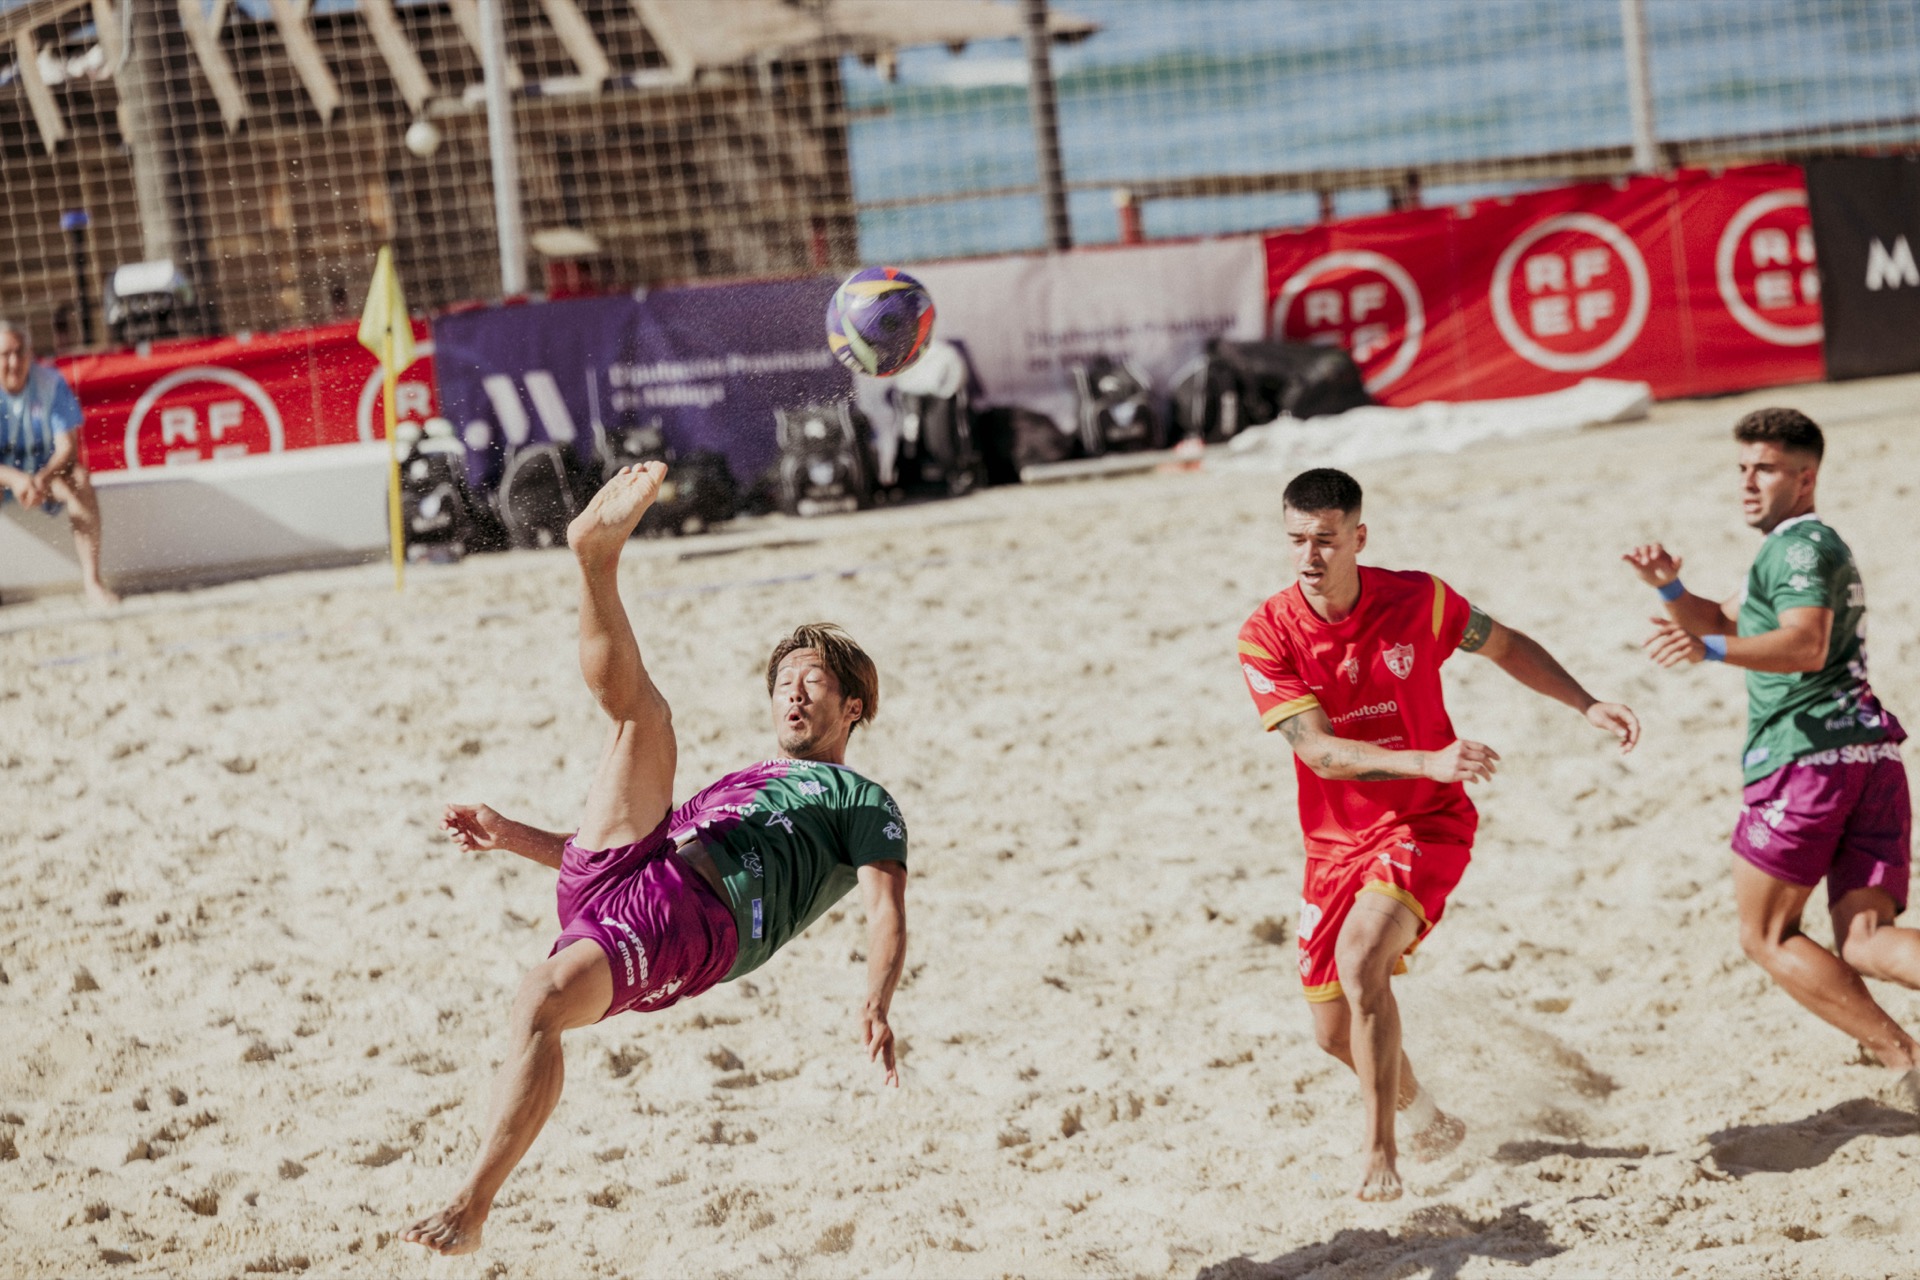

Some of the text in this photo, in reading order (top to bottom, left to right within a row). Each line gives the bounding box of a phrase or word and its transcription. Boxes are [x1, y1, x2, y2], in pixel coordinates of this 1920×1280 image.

[1524, 248, 1611, 293] RF
[1303, 281, 1387, 328] RF
[1530, 289, 1615, 336] EF
[160, 400, 243, 446] RF
